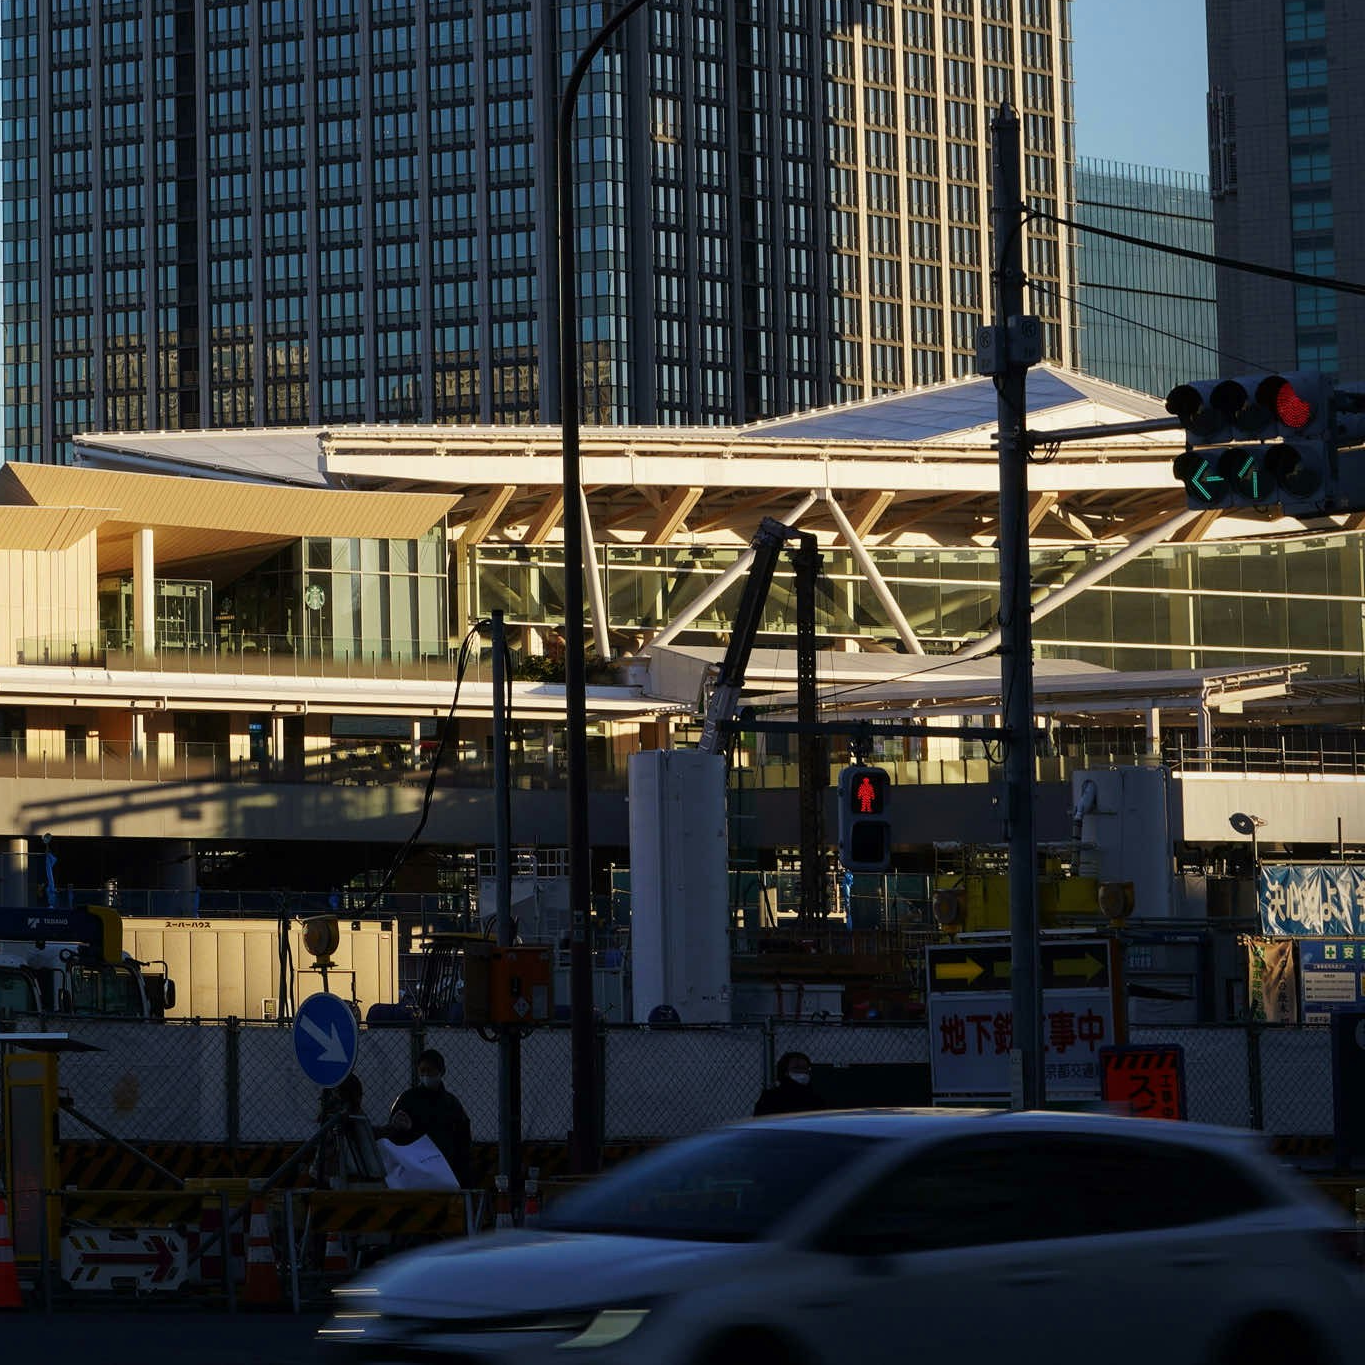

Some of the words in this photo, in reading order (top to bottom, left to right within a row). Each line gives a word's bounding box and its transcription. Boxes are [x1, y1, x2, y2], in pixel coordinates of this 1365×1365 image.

[940, 1008, 1105, 1056] 地下鉄事中
